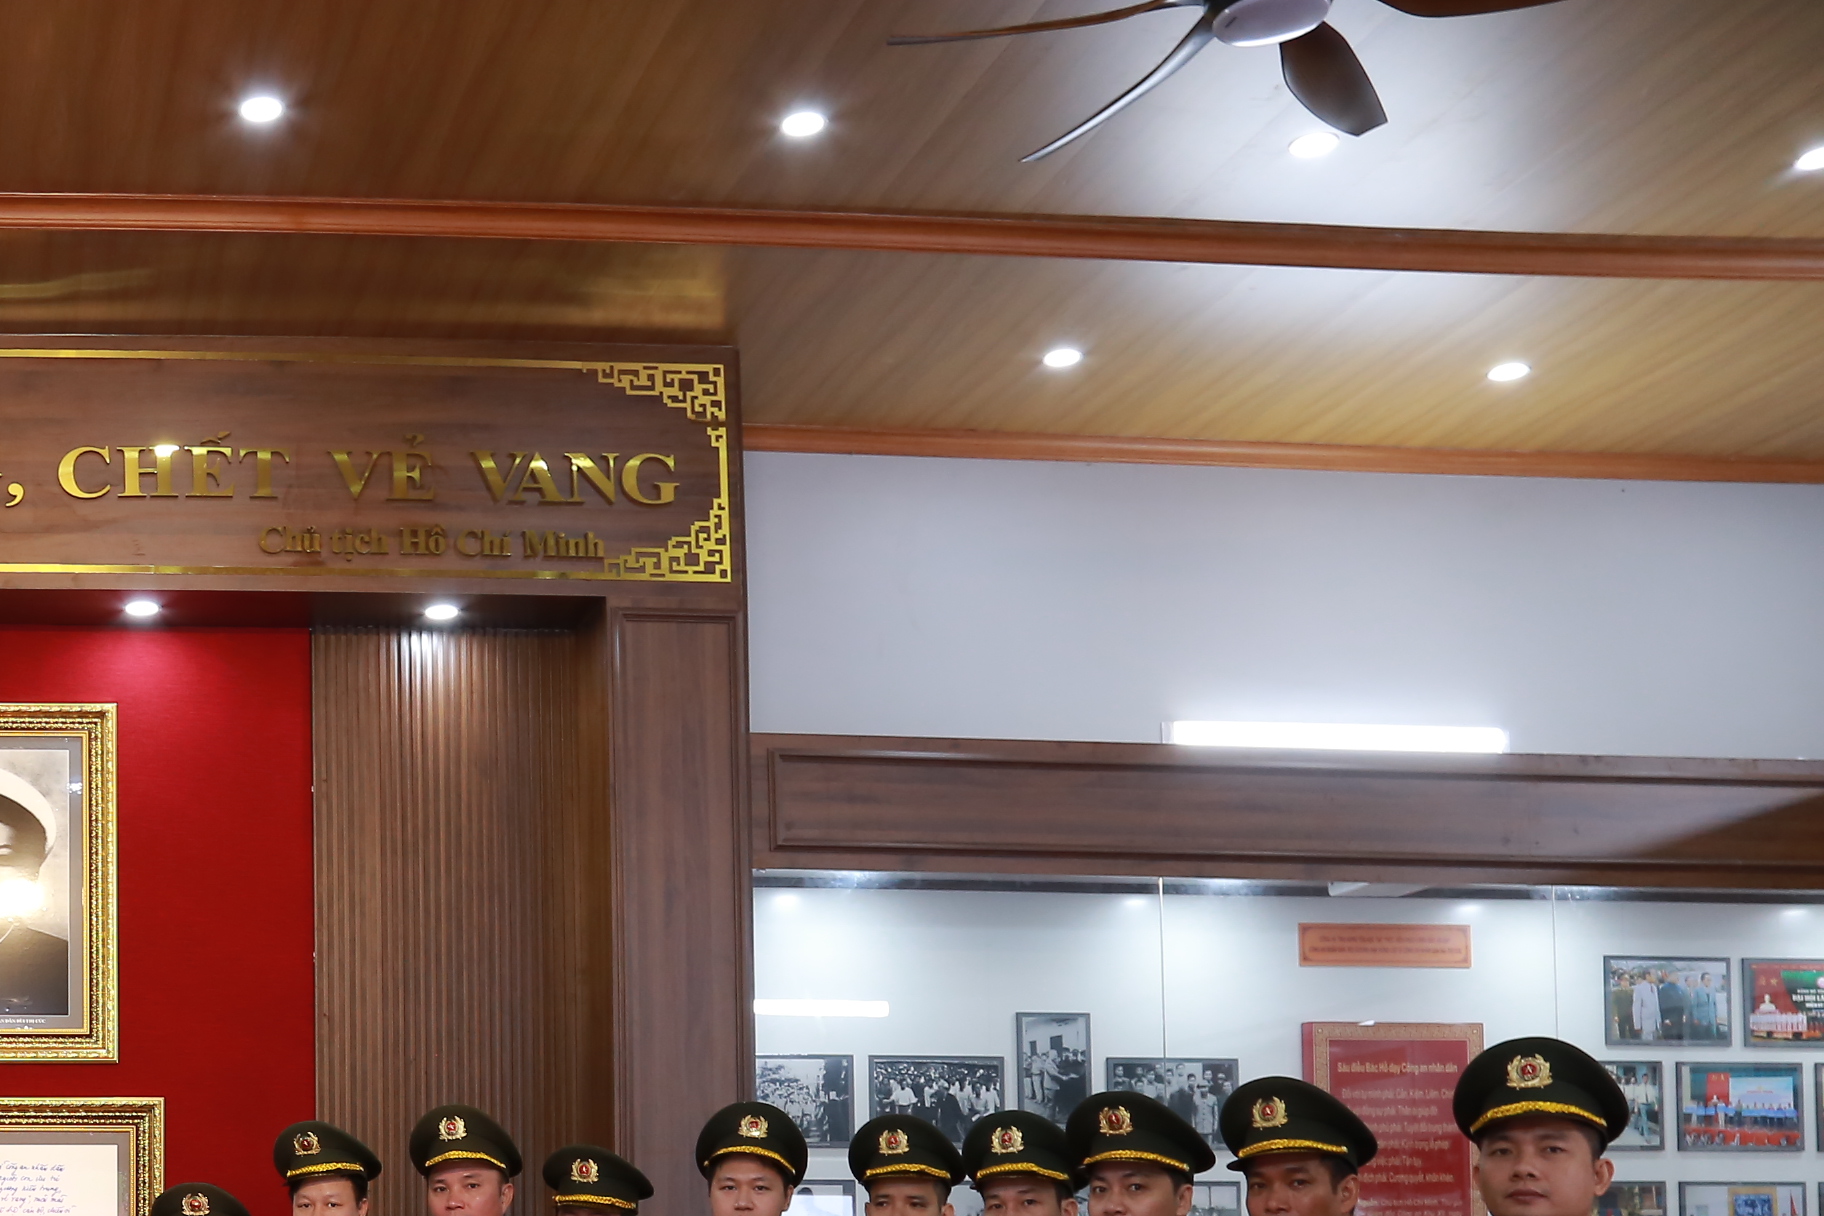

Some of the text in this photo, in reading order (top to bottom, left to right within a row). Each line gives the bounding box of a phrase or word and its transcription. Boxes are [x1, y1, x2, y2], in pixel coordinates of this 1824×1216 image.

[57, 431, 290, 499] CHẾT
[328, 433, 435, 501] VẺ
[470, 450, 679, 506] VANG
[258, 526, 322, 554] Chủ
[330, 528, 389, 562] tịch
[456, 529, 512, 557] Chí
[522, 530, 605, 558] Minh
